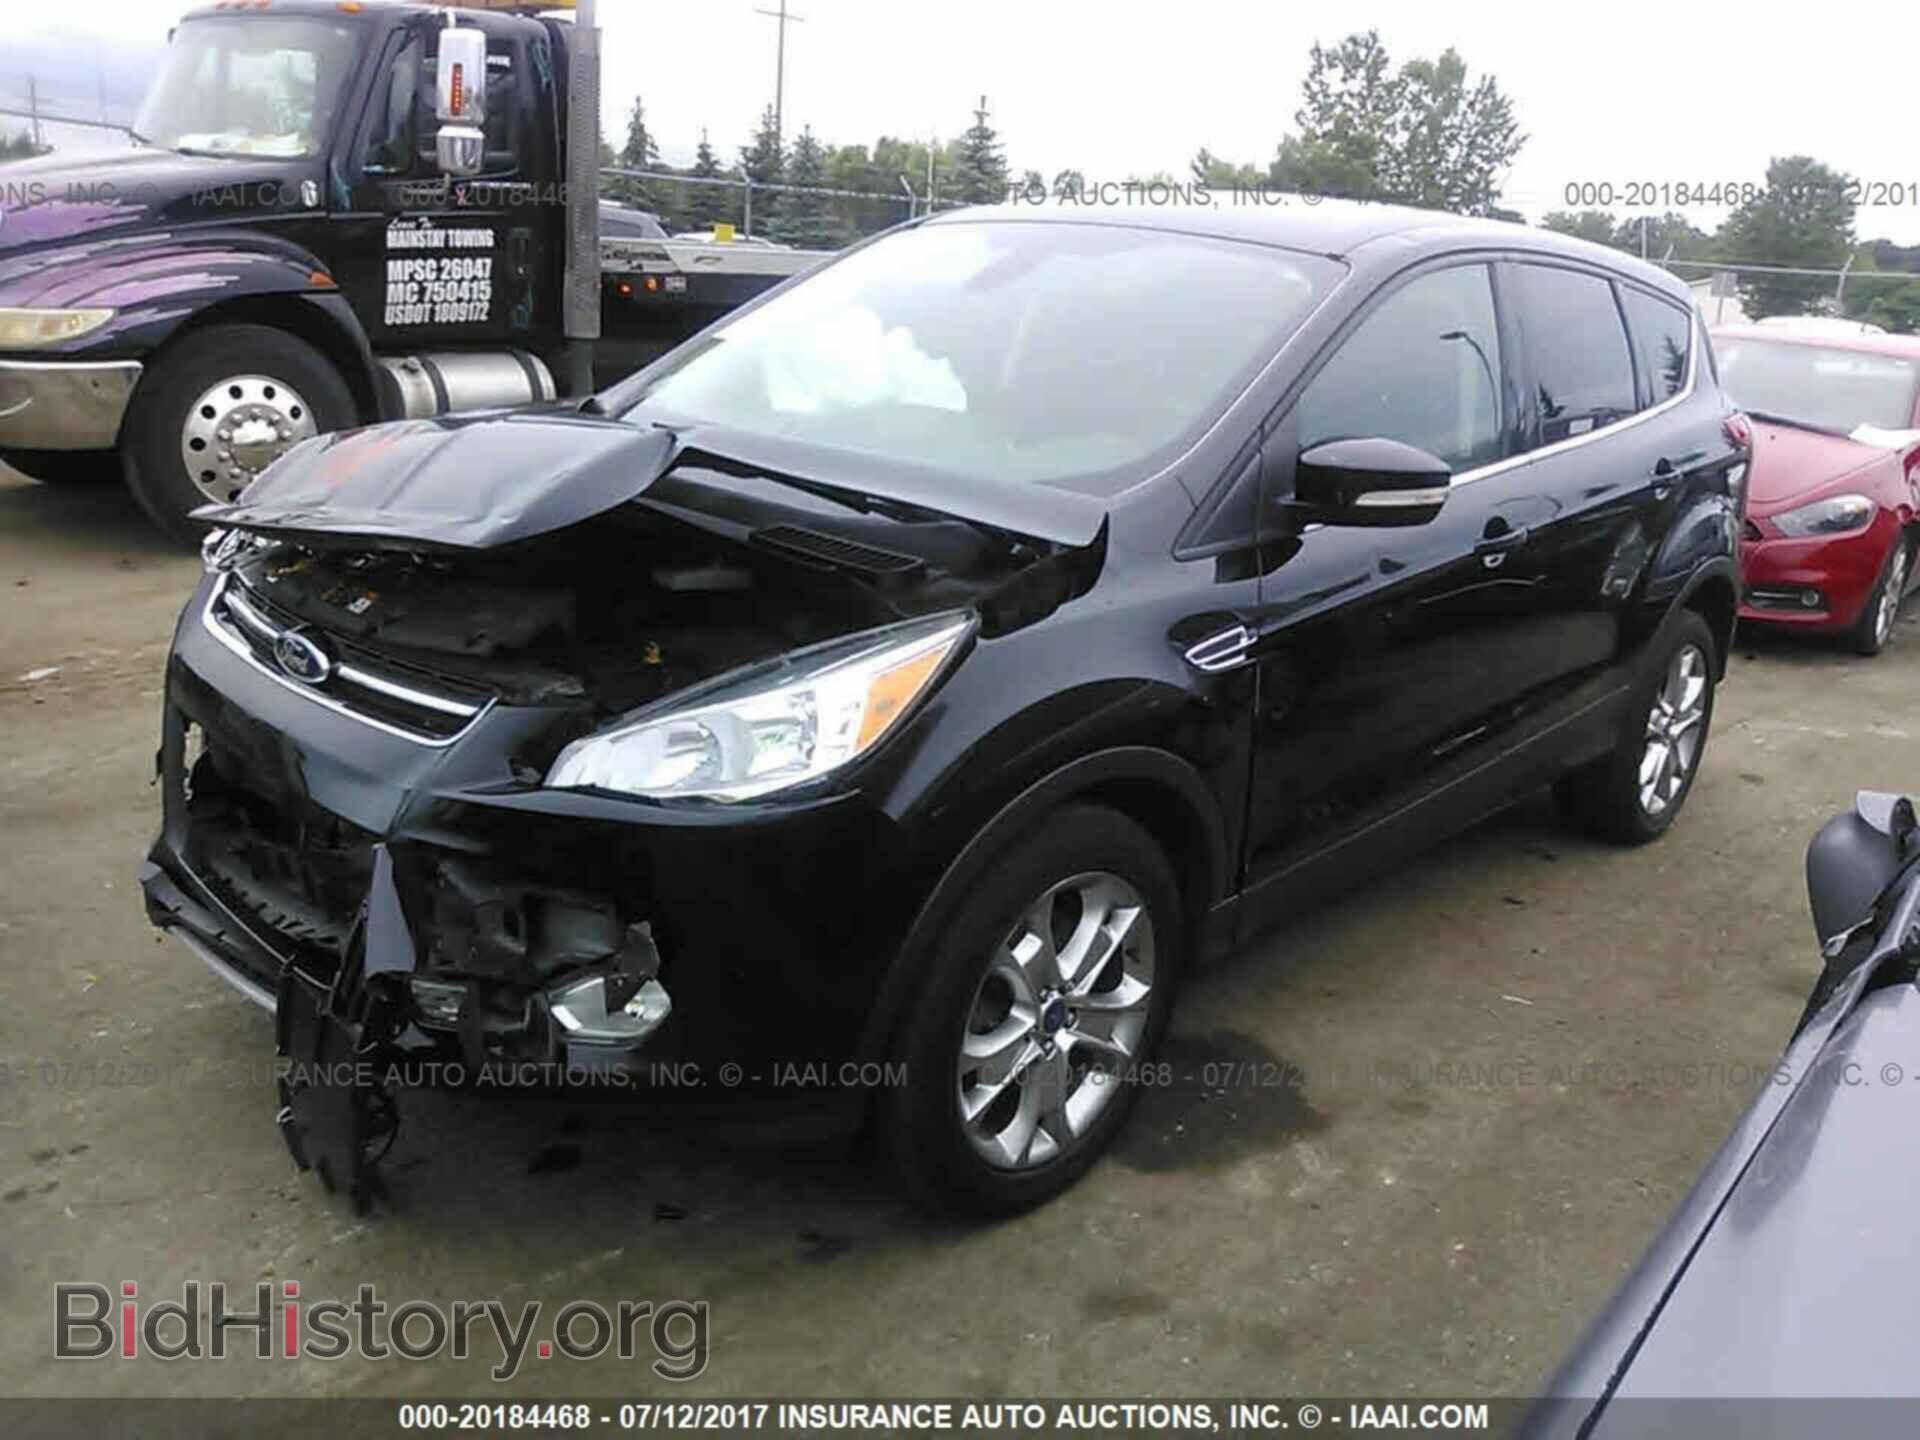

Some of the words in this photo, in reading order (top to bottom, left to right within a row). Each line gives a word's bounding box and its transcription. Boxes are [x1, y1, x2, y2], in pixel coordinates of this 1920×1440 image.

[386, 229, 446, 249] MAINSTAY
[447, 228, 495, 248] TOWING
[387, 258, 437, 281] MPSC
[440, 257, 493, 280] 26047
[386, 281, 420, 303] MC
[422, 280, 492, 302] 750415
[384, 303, 432, 325] USDOT
